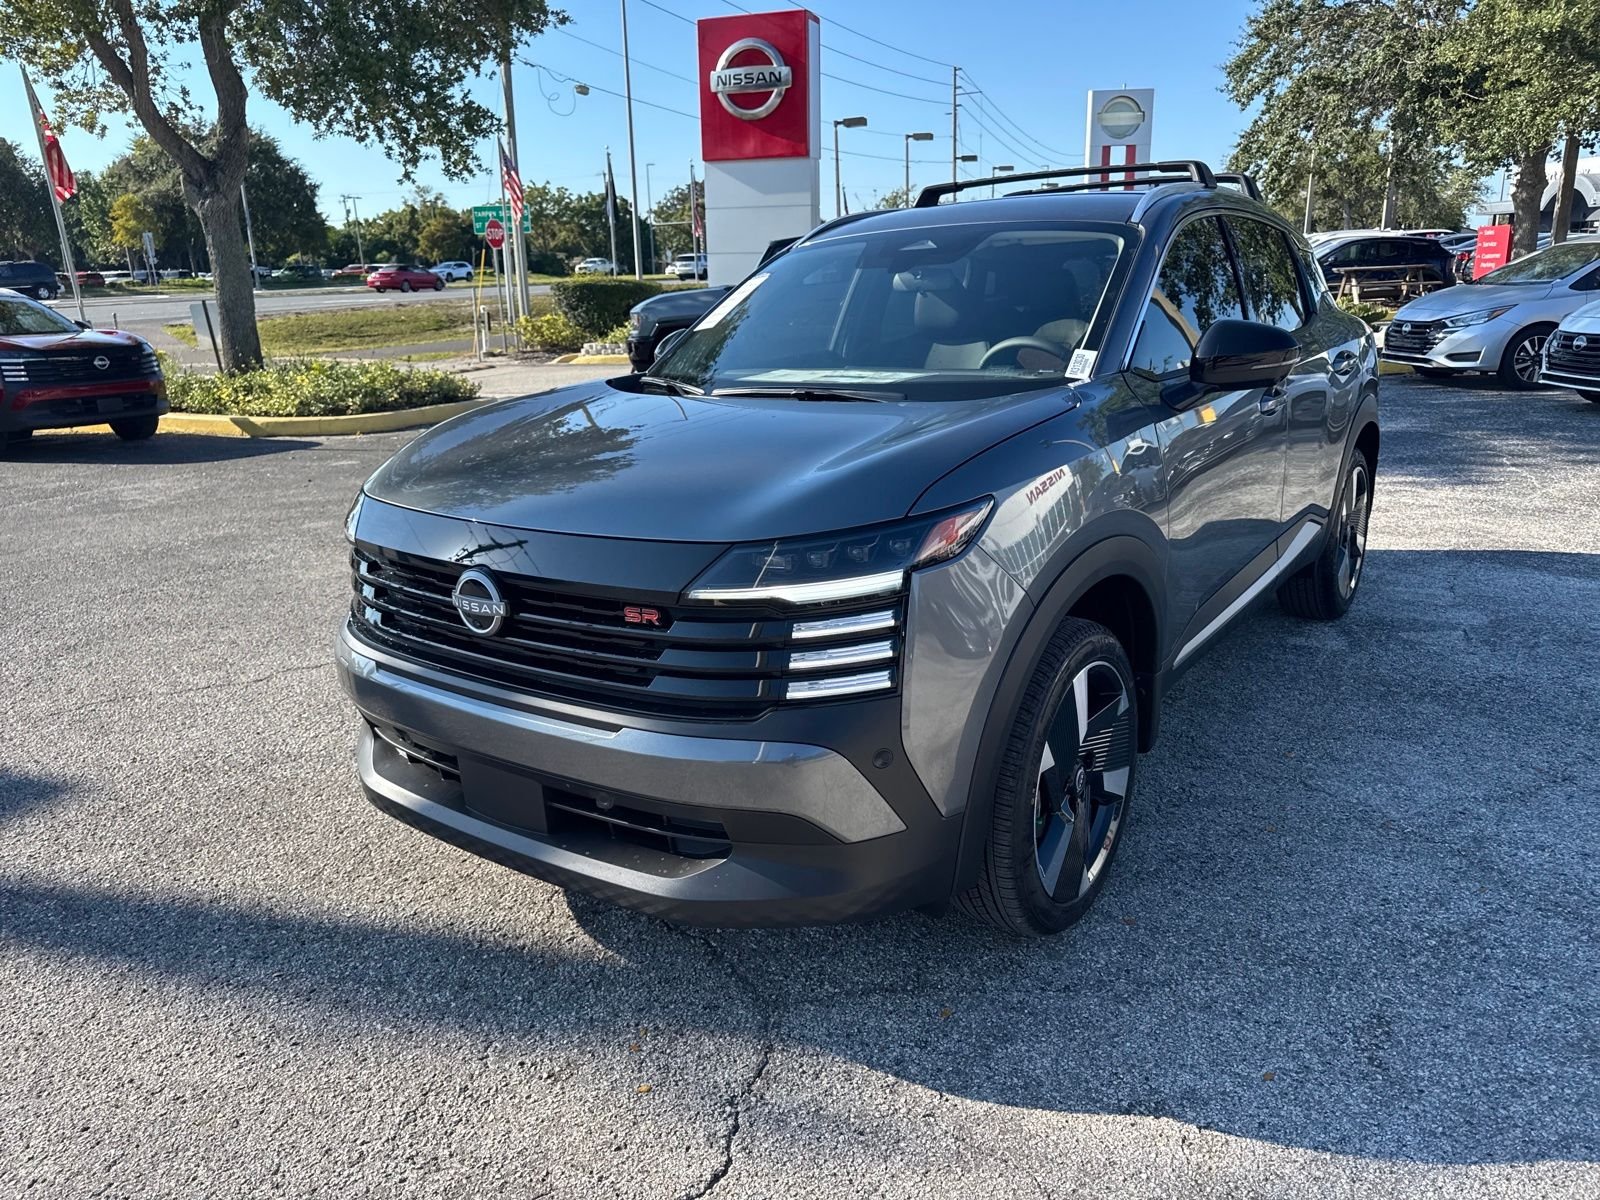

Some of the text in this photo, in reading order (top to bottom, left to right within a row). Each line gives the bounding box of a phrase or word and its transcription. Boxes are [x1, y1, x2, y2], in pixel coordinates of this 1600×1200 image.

[716, 71, 782, 87] NISSAN
[487, 228, 504, 240] STOP
[453, 595, 504, 615] NISSAN
[623, 606, 660, 626] SR
